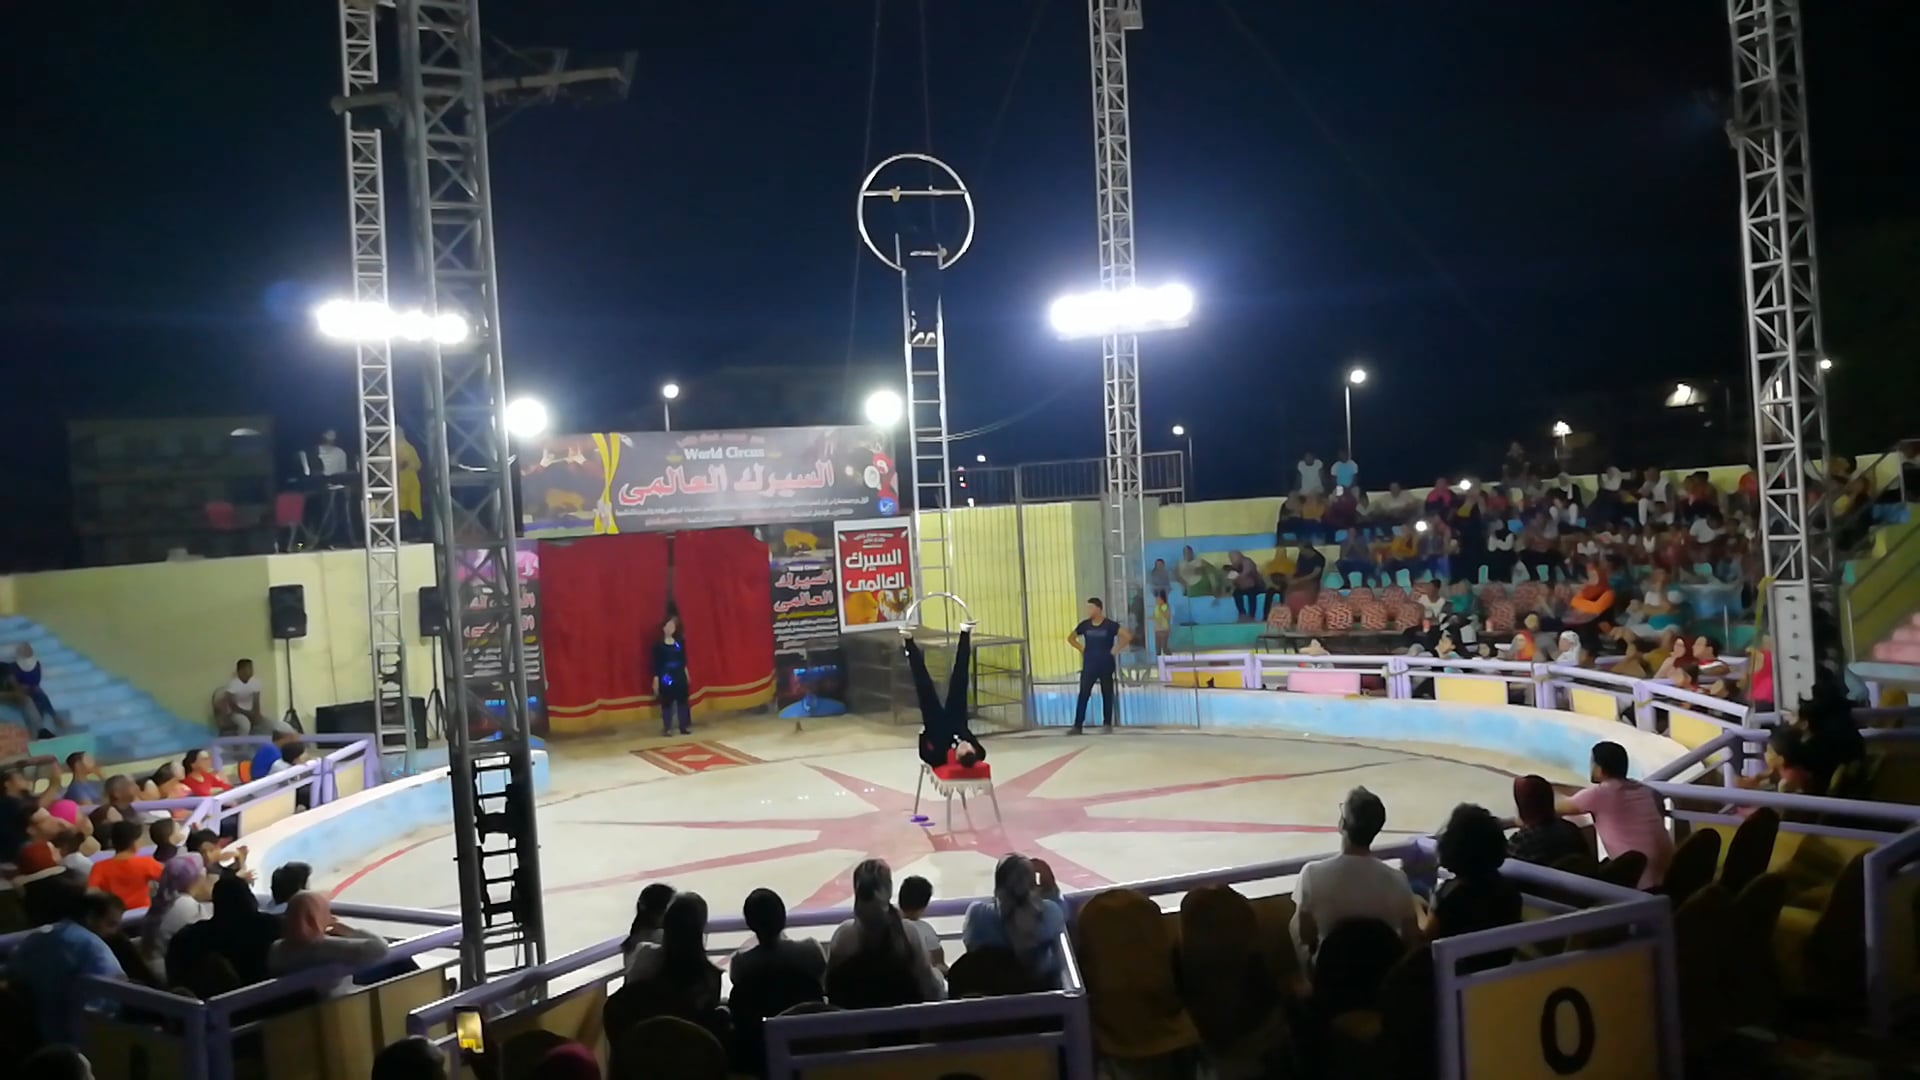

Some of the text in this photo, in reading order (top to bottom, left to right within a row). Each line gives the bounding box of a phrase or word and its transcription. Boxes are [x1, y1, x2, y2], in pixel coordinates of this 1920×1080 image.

[683, 446, 765, 461] World Circus
[734, 459, 835, 498] السيرك
[845, 548, 902, 572] السيرك
[774, 569, 834, 590] السيرك
